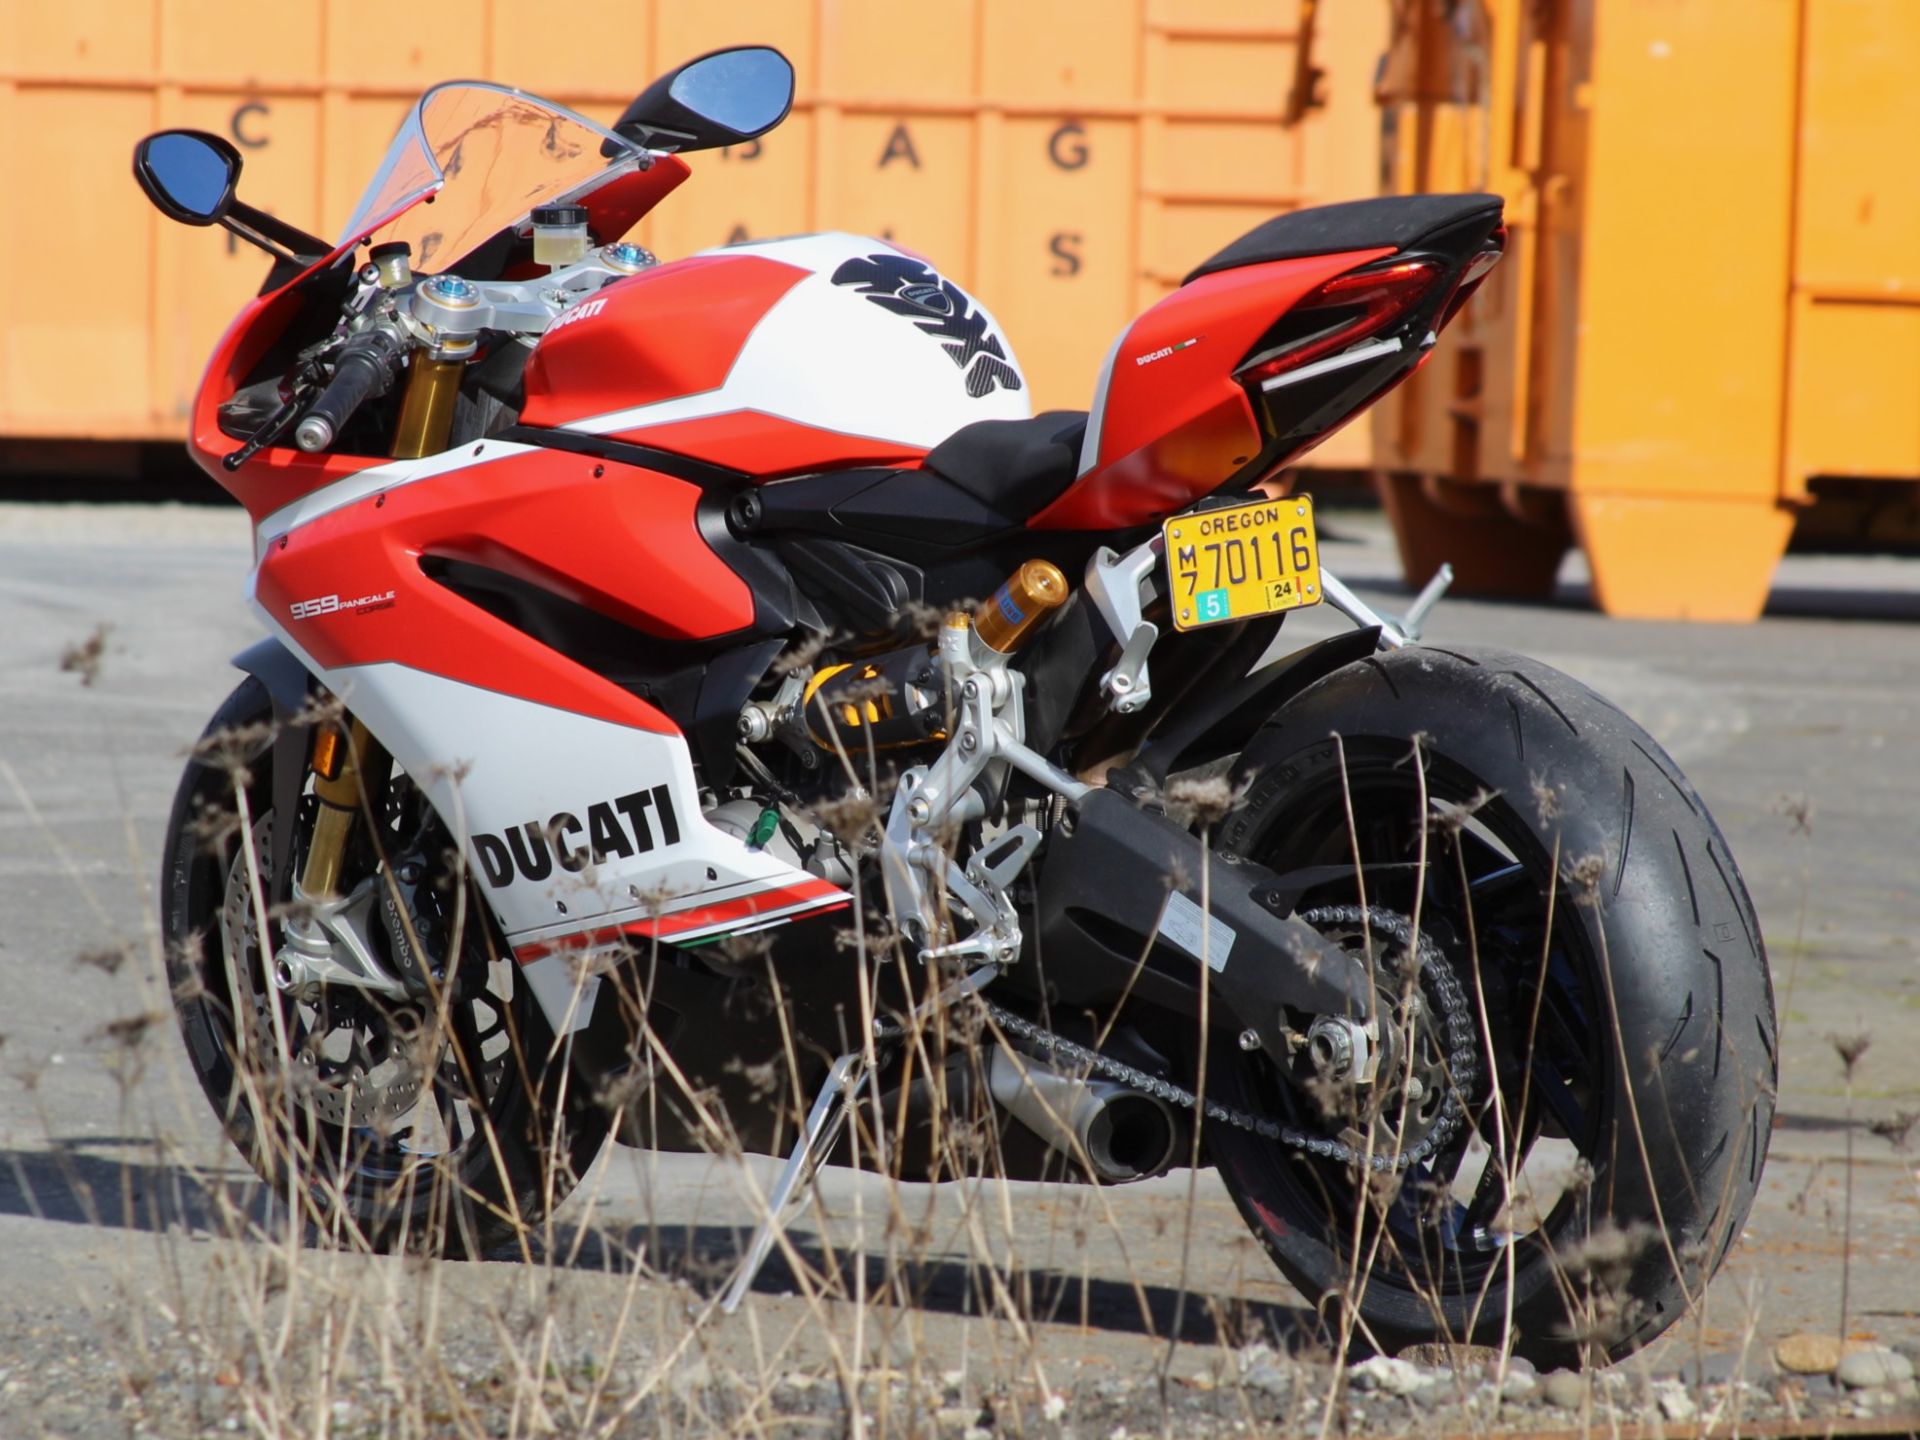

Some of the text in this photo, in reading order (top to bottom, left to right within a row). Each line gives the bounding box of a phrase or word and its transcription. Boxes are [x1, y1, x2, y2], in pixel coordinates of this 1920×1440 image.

[1049, 232, 1083, 277] S
[1136, 346, 1173, 366] DUCATI
[1200, 507, 1279, 536] OREGON
[1204, 527, 1310, 588] 70116
[1274, 582, 1292, 598] 24
[290, 590, 395, 620] 959 PANIGALE
[1207, 594, 1221, 617] 5
[470, 783, 681, 889] DUCATI
